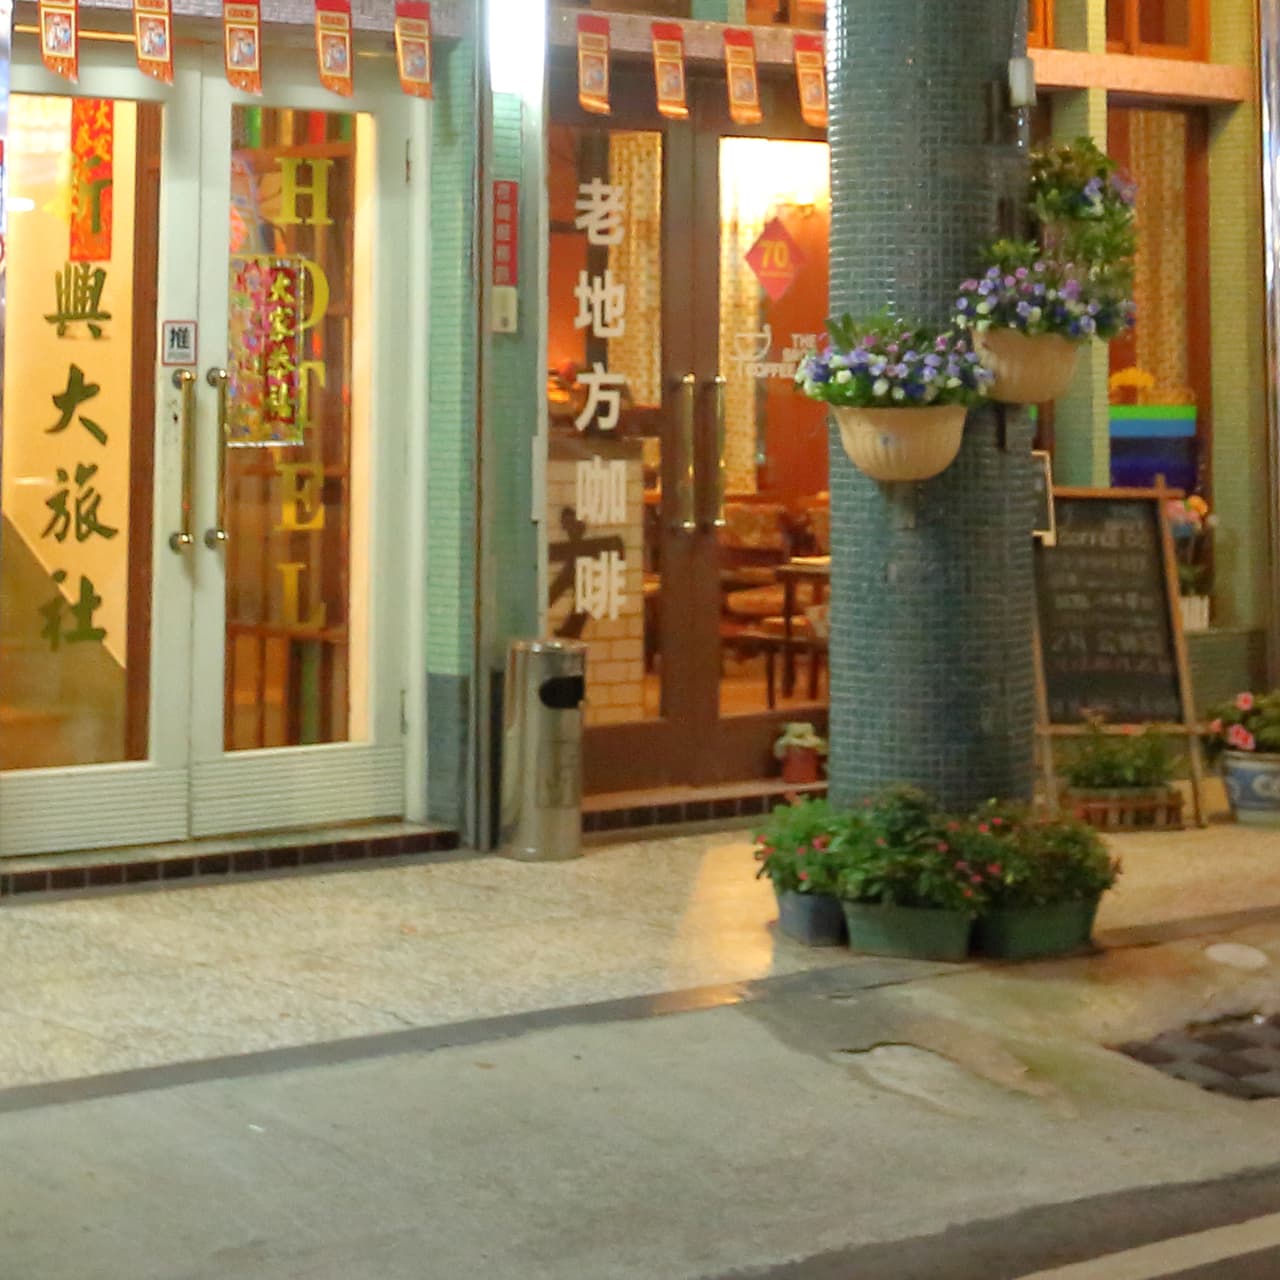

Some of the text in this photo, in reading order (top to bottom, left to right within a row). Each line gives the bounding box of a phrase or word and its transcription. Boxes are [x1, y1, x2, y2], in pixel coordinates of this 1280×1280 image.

[575, 179, 628, 621] 老地方咖啡
